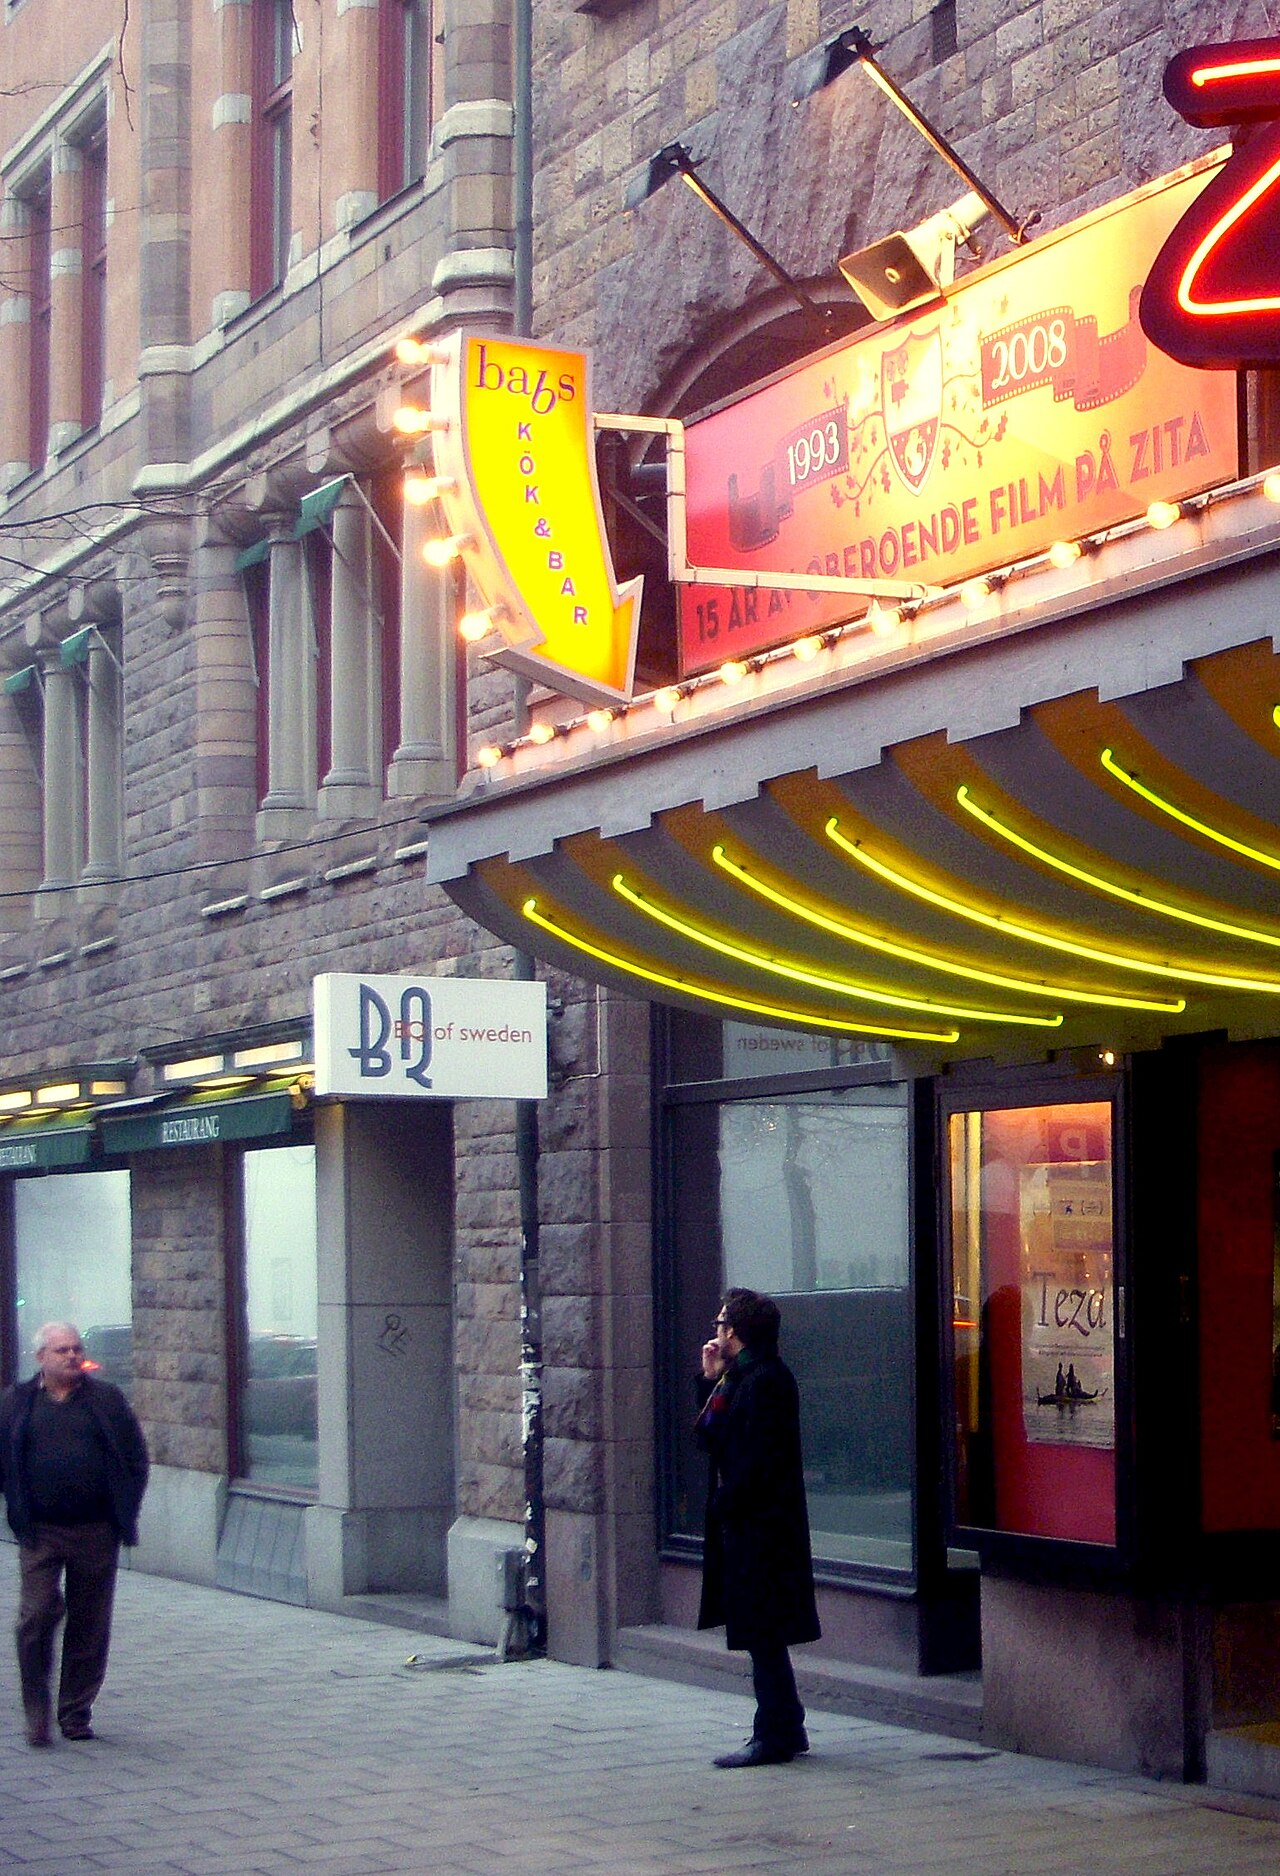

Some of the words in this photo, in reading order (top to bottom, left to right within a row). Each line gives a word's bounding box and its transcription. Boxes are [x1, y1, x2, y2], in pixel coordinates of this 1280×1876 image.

[474, 344, 576, 415] babs
[991, 319, 1067, 390] 2008
[787, 421, 840, 485] 1993
[517, 421, 540, 505] KÖK
[534, 518, 551, 538] &
[548, 551, 588, 626] BAR
[696, 599, 719, 642] 15
[805, 498, 981, 604] OBEROENDE
[990, 465, 1065, 534] FILM
[1075, 429, 1120, 503] PÅ
[1130, 410, 1211, 484] ZITA
[434, 1022, 455, 1041] of
[459, 1024, 533, 1043] sweden
[162, 1114, 221, 1144] RESTAURANG
[1032, 1271, 1107, 1337] Teza
